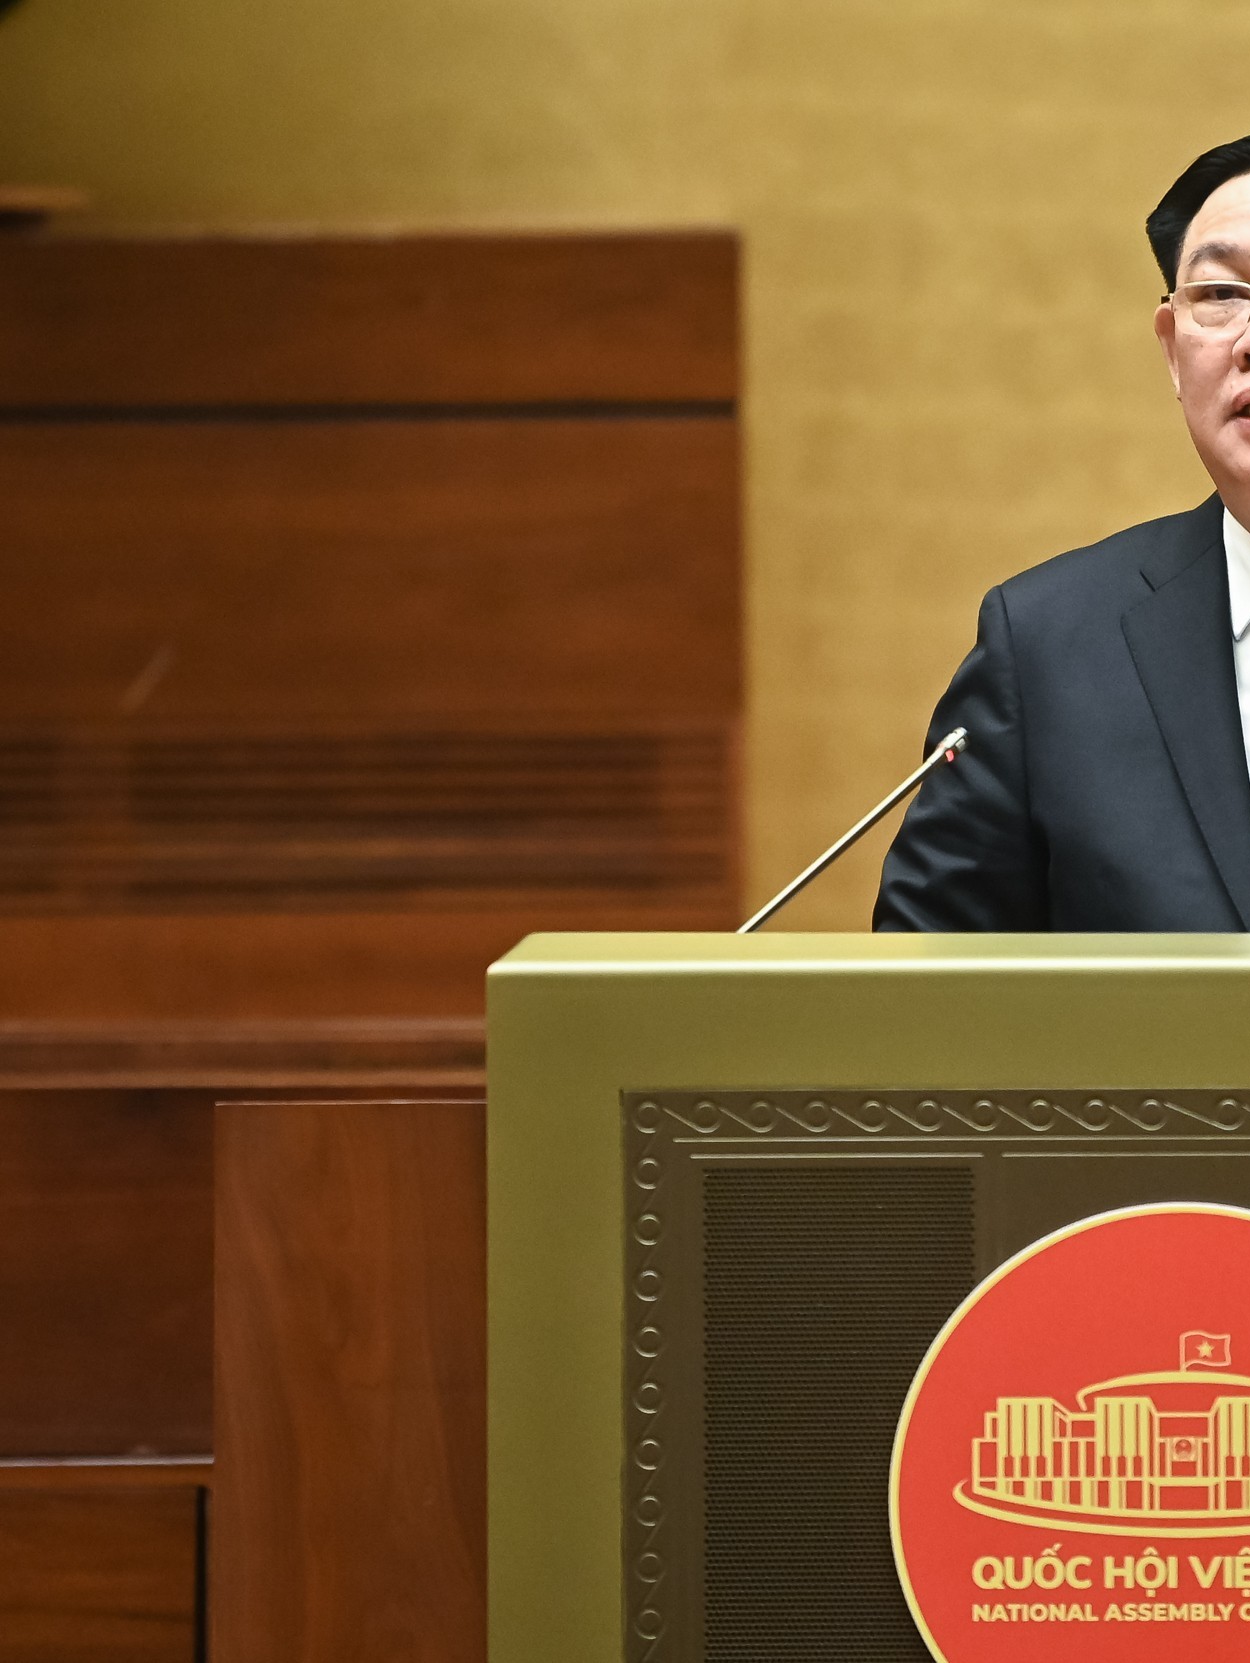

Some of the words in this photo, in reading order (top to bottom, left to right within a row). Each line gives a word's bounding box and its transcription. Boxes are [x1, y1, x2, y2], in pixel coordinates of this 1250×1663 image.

[972, 1543, 1092, 1590] QUỐC
[1104, 1546, 1179, 1597] HỘI
[972, 1603, 1099, 1621] NATIONAL
[1104, 1603, 1234, 1621] ASSEMBLY
